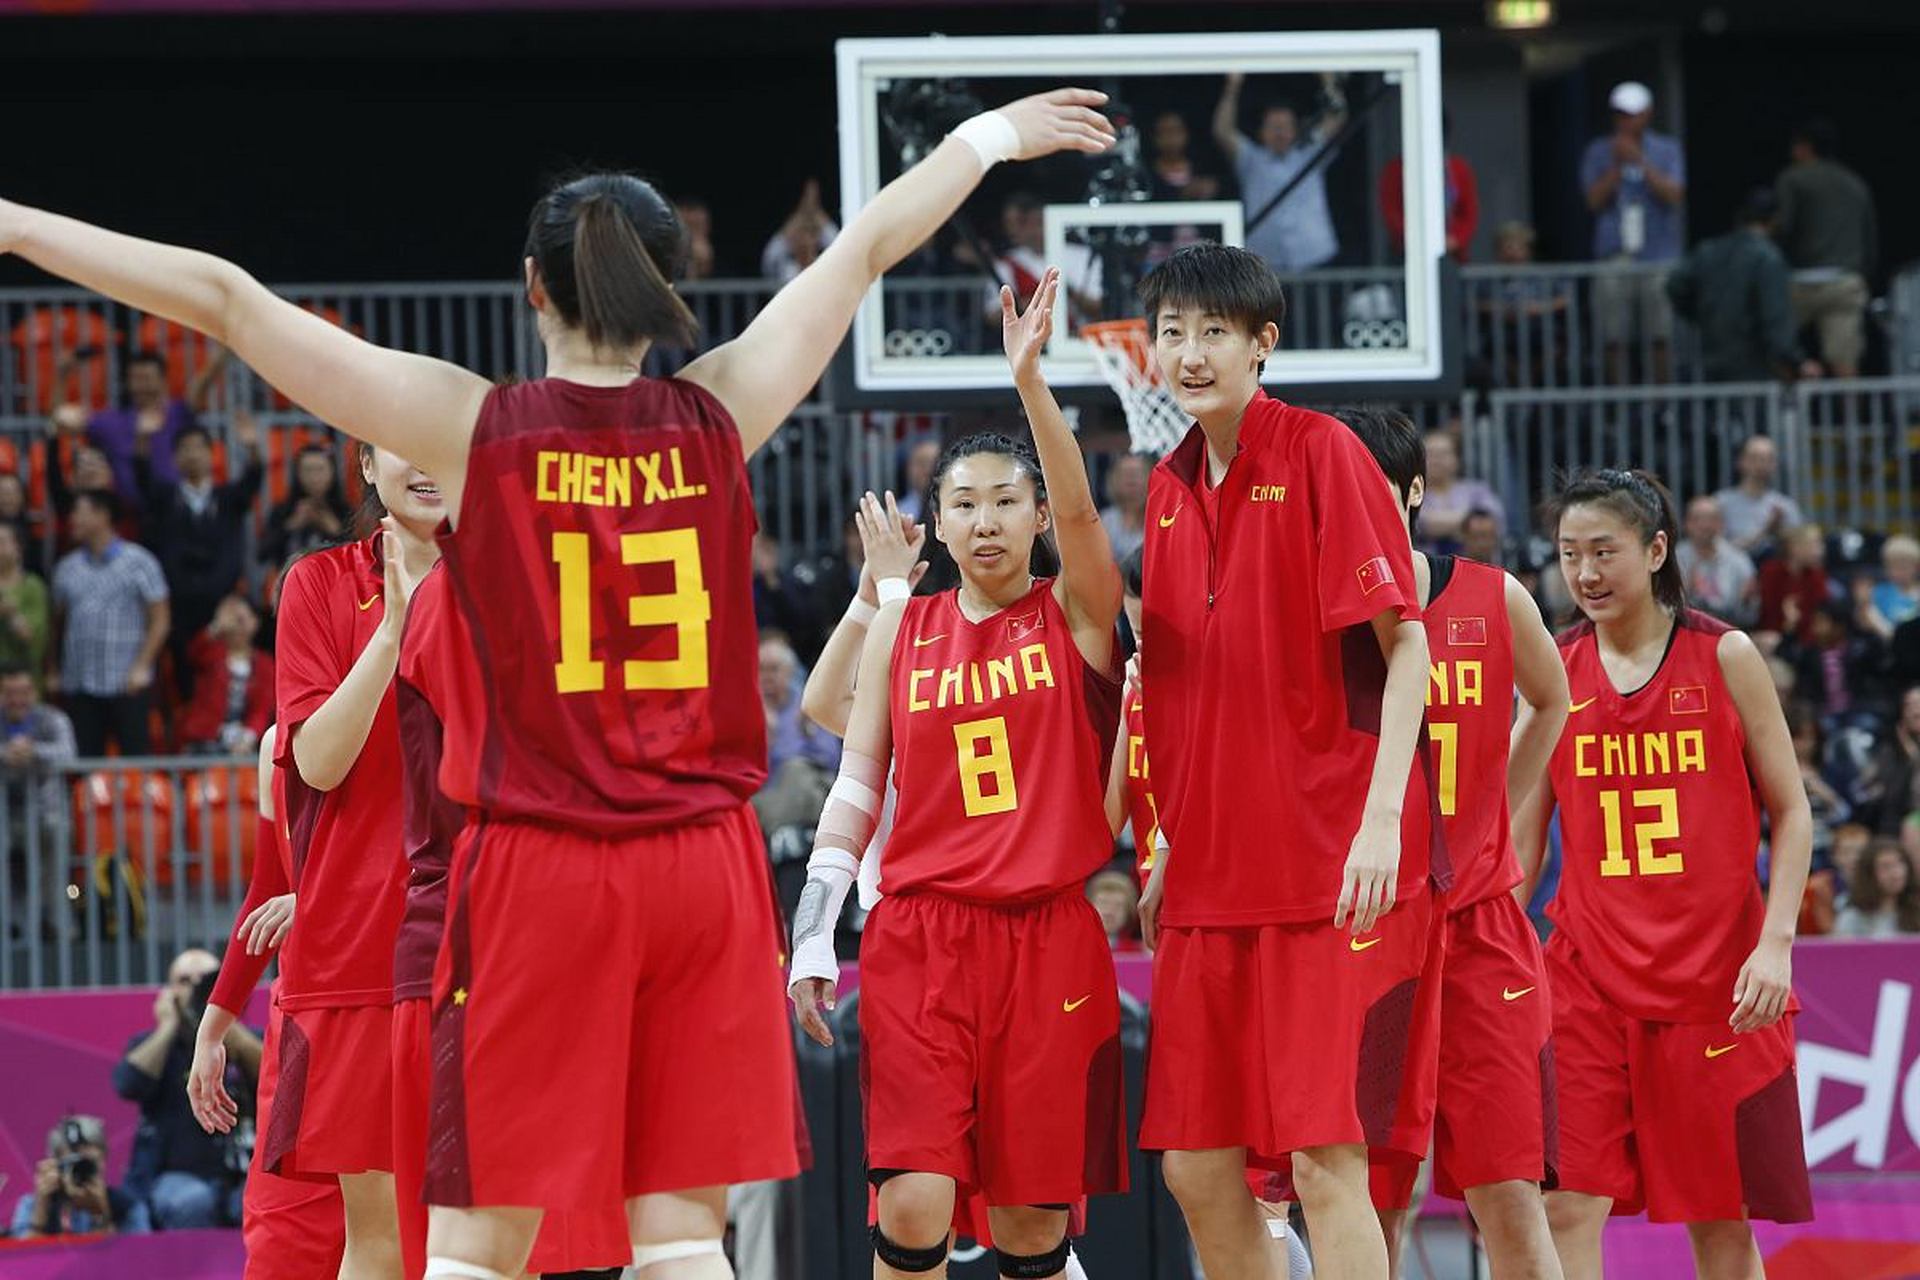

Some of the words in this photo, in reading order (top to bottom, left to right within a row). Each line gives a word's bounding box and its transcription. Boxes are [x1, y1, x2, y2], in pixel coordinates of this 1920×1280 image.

[537, 451, 632, 507] CHEN
[635, 447, 707, 504] X.L.
[552, 527, 711, 693] 13
[909, 643, 1055, 712] CHINA
[953, 716, 1019, 817] 8
[1575, 730, 1706, 776] CHINA
[1600, 788, 1684, 876] 12
